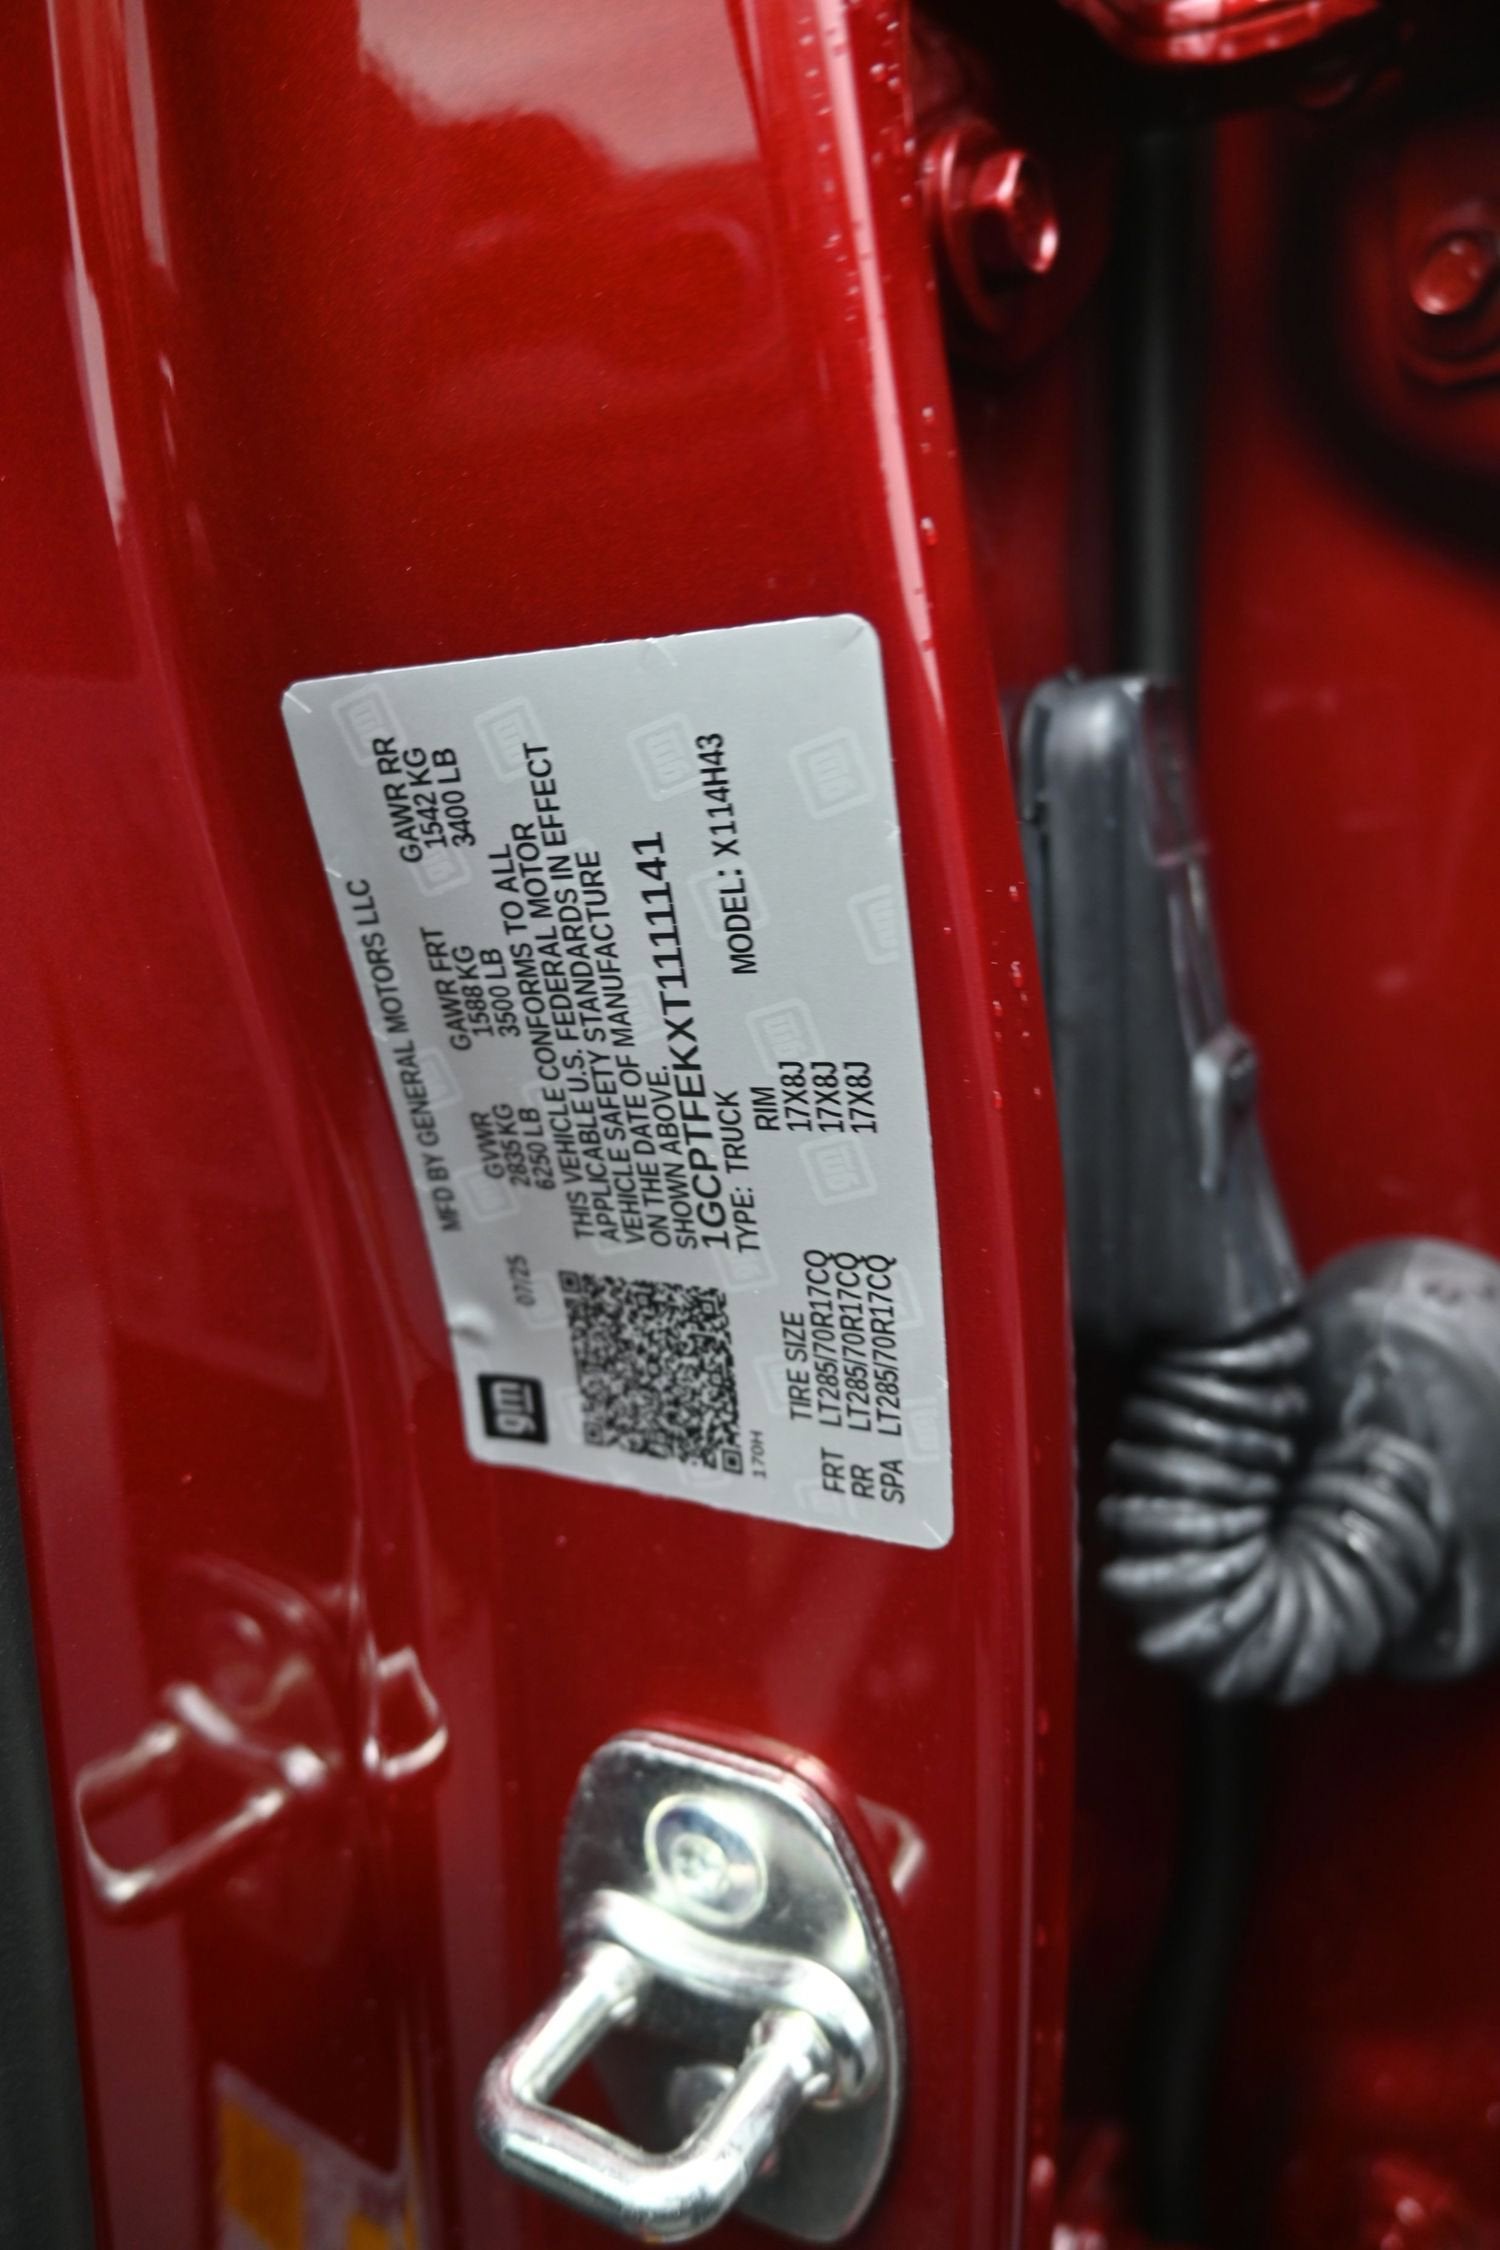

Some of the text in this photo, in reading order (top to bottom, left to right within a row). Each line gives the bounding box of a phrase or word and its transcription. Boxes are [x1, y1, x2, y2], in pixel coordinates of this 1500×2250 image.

[372, 736, 424, 864] GAWR RR
[403, 748, 432, 786] KG
[432, 748, 476, 847] 3400 LB
[696, 733, 740, 857] X114H43
[414, 792, 448, 848] 1542
[346, 878, 380, 924] LLC
[718, 869, 758, 974] MODEL:
[362, 932, 409, 1034] MOTORS
[420, 926, 472, 1051] GAWR FRT
[452, 946, 494, 1036] 1588 KG
[480, 948, 520, 1037] 3500 LB
[523, 742, 646, 1244] VEHICLE SAFETY STANDARDS IN EFFECT
[488, 844, 595, 1240] THIS VEHICLE CONFORMS TO ALL
[510, 822, 620, 1242] APPLICABLE U.S. FEDERAL MOTOR
[576, 851, 671, 1247] ON THE DATE OF MANUFACTURE
[632, 832, 730, 1250] 1GCPTFEKXT1111141
[392, 1040, 440, 1146] GENERAL
[713, 1090, 749, 1174] TRUCK
[750, 1086, 780, 1132] RIM
[778, 1061, 812, 1132] 17X8J
[810, 1061, 844, 1132] 17X8J
[843, 1061, 878, 1134] 17X8J
[422, 1154, 449, 1180] BY
[470, 1111, 505, 1179] GVWR
[492, 1104, 531, 1188] 2835 KG
[518, 1108, 556, 1190] 6250 LB
[646, 1066, 697, 1250] SHOWN ABOVE.
[432, 1186, 462, 1232] MFD
[730, 1188, 760, 1253] TYPE:
[505, 1254, 536, 1307] 07/25
[780, 1311, 812, 1420] TIRE SIZE
[804, 1250, 842, 1427] LT285/70R17CQ
[833, 1252, 874, 1499] RR LT285/70R17CQ
[865, 1255, 904, 1504] SPA LT285/70R17CQ
[750, 1430, 766, 1479] 170H
[821, 1448, 845, 1494] FRT
